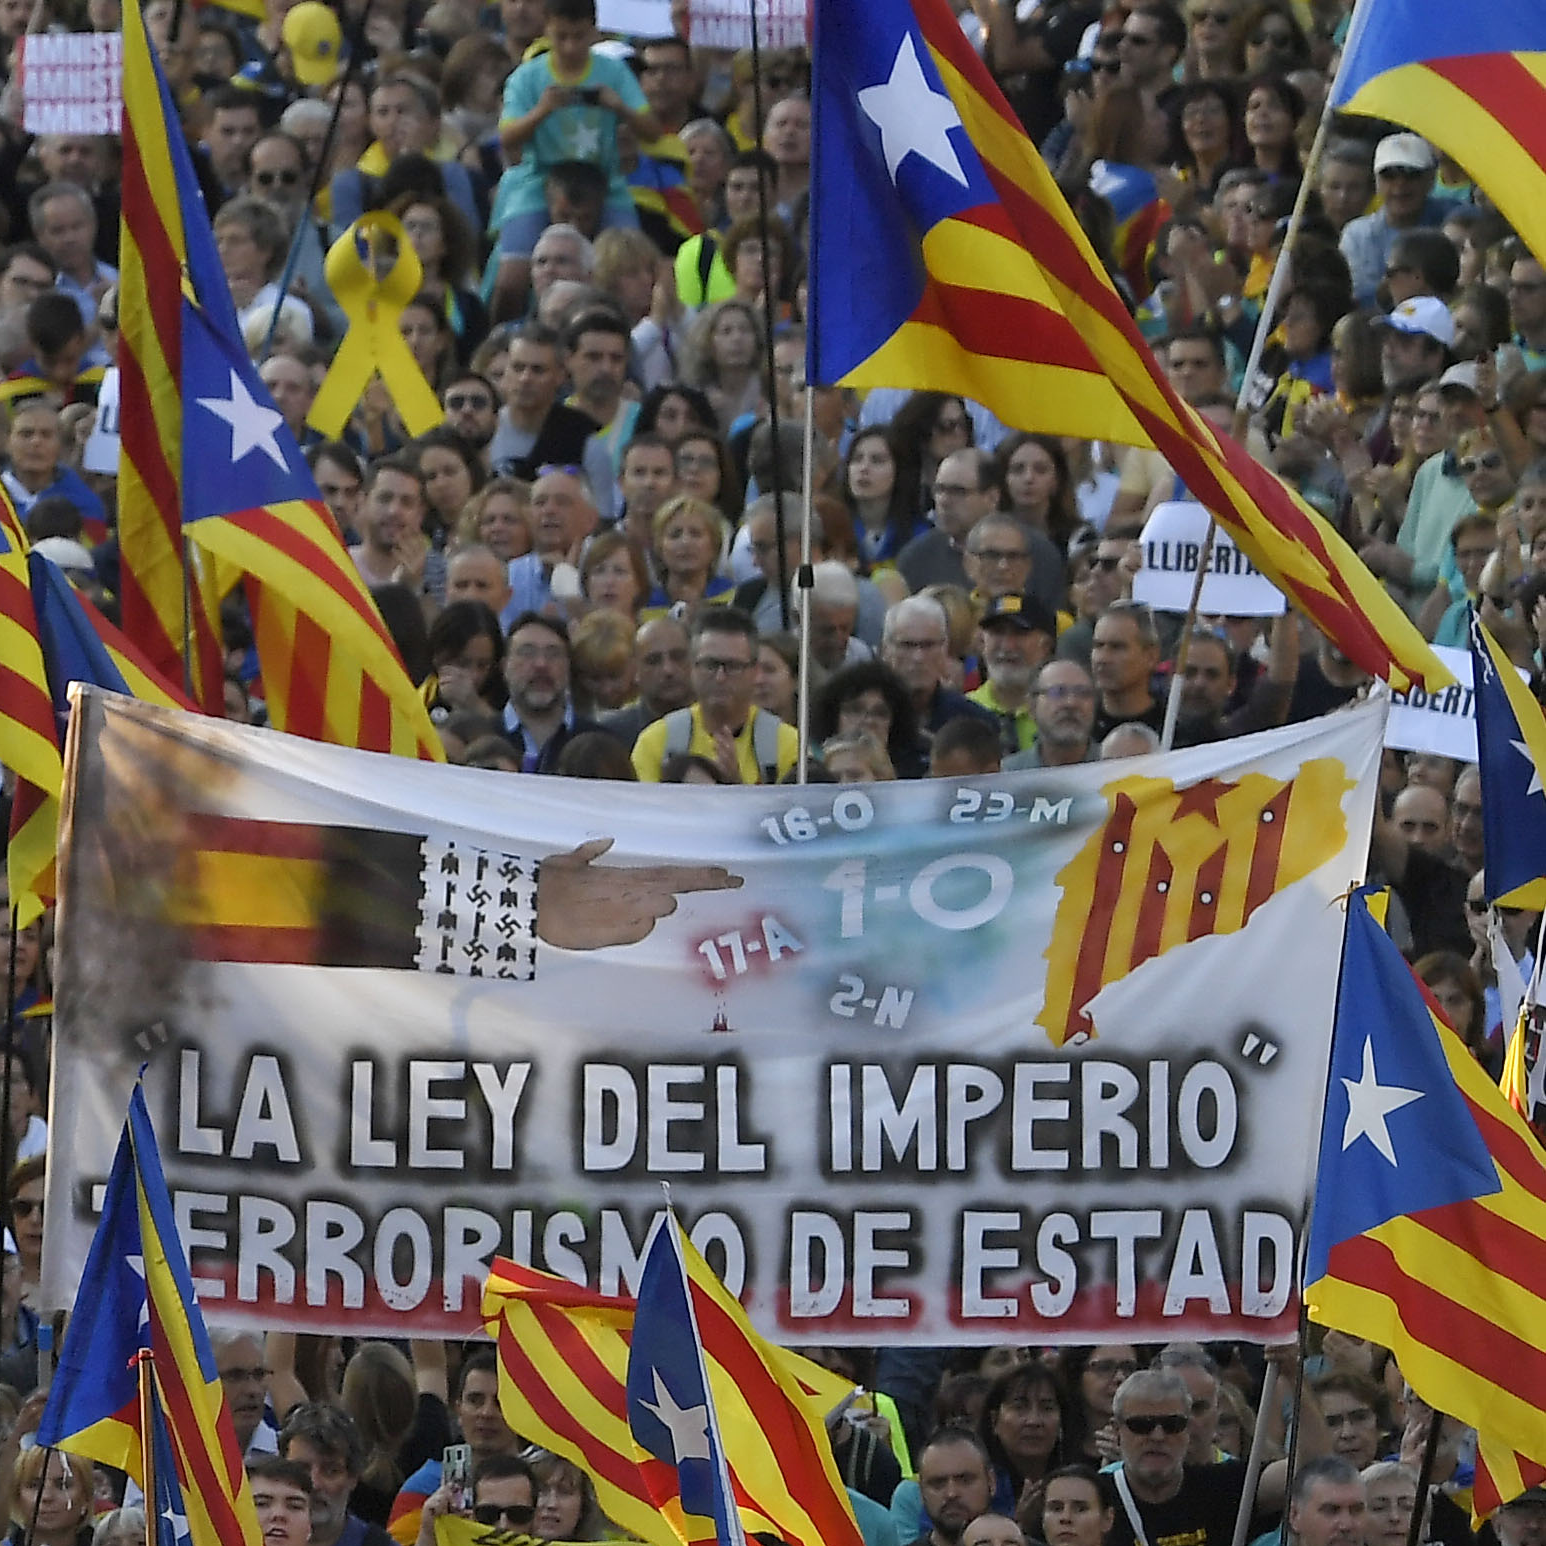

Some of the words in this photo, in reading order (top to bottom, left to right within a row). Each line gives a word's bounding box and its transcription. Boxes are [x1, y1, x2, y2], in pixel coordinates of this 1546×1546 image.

[698, 914, 805, 980] 17-A
[350, 1059, 533, 1169] LEY
[583, 1062, 766, 1172] DEL
[92, 1184, 746, 1312] ERRORISMO
[790, 1208, 911, 1318] DE
[961, 1208, 1306, 1319] ESTAD
